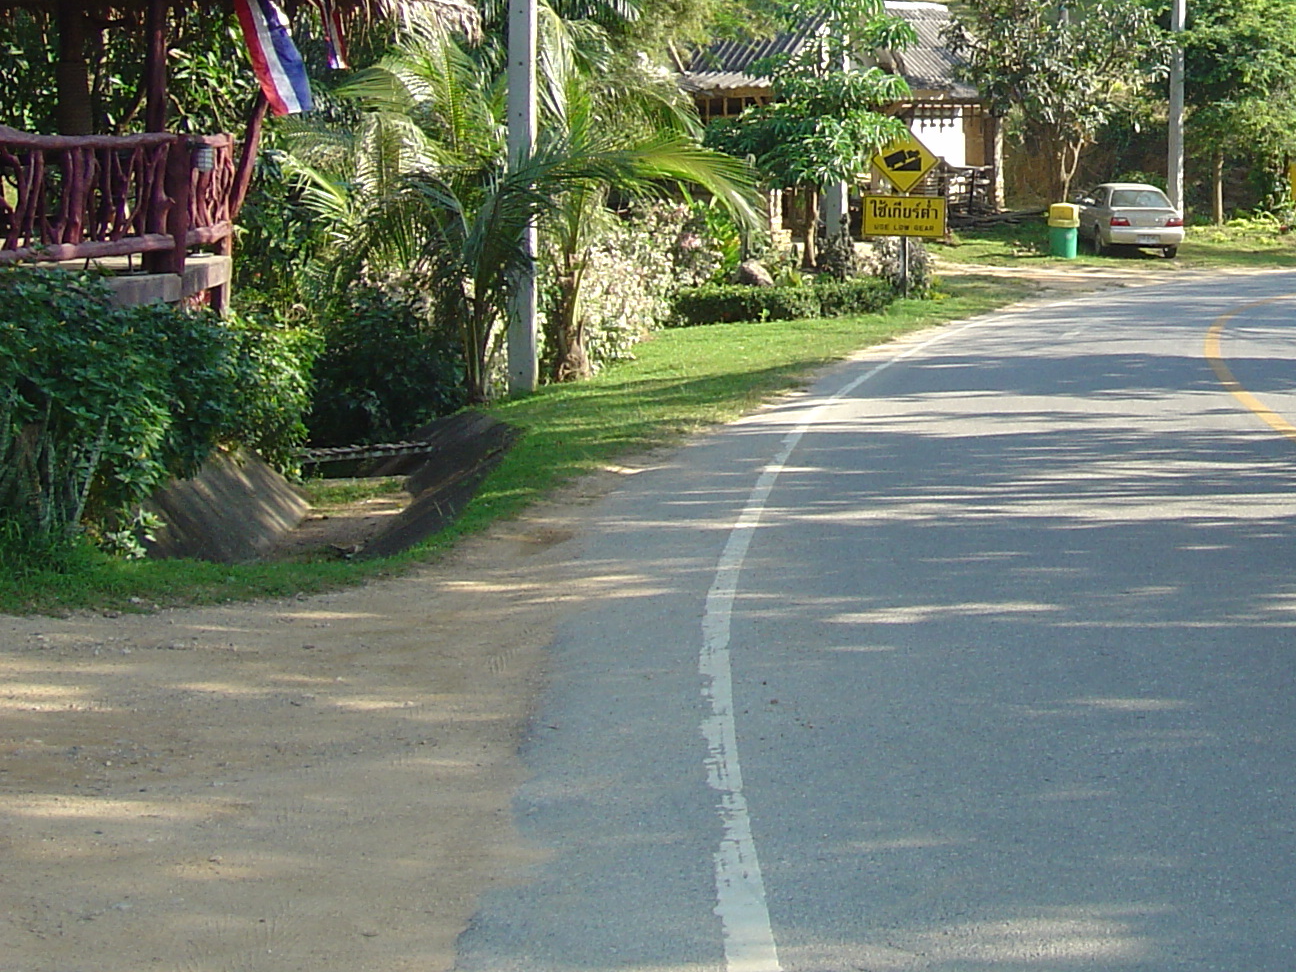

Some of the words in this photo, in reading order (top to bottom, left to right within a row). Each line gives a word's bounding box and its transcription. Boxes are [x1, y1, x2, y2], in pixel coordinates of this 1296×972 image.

[870, 199, 938, 219] ใช้เกียร์ต่ำ
